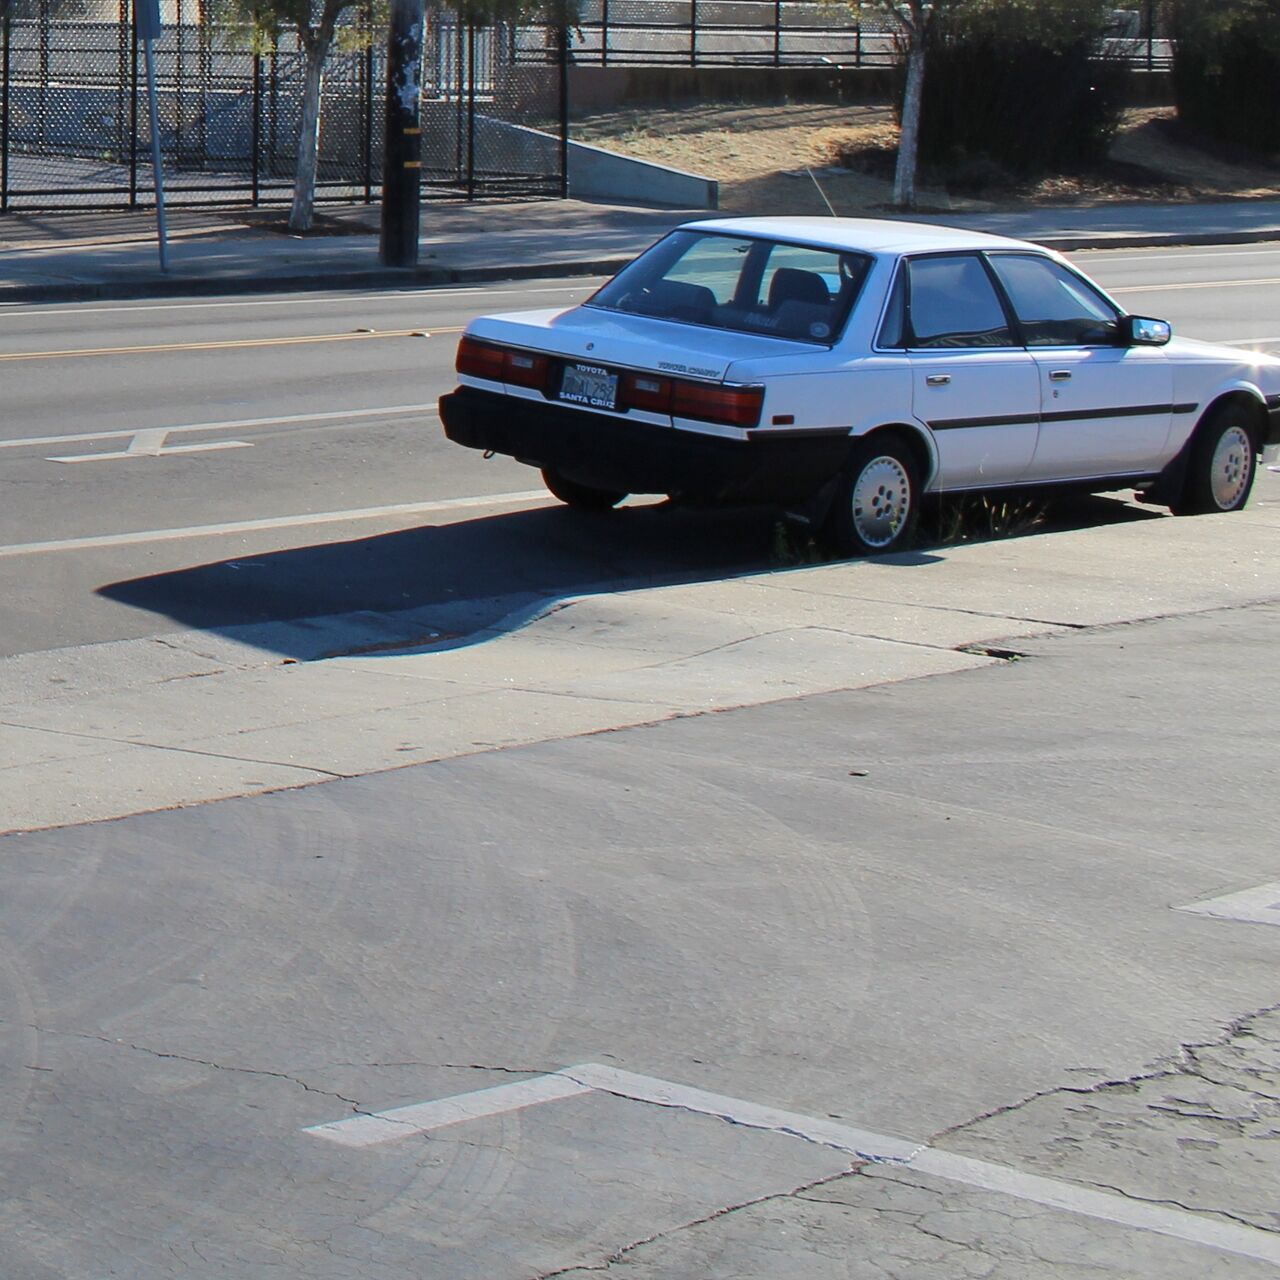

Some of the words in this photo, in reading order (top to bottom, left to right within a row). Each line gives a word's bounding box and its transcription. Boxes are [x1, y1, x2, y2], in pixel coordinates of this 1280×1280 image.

[575, 364, 608, 376] TOYOTA
[559, 391, 589, 404] SANTA
[590, 397, 616, 409] CRUZ
